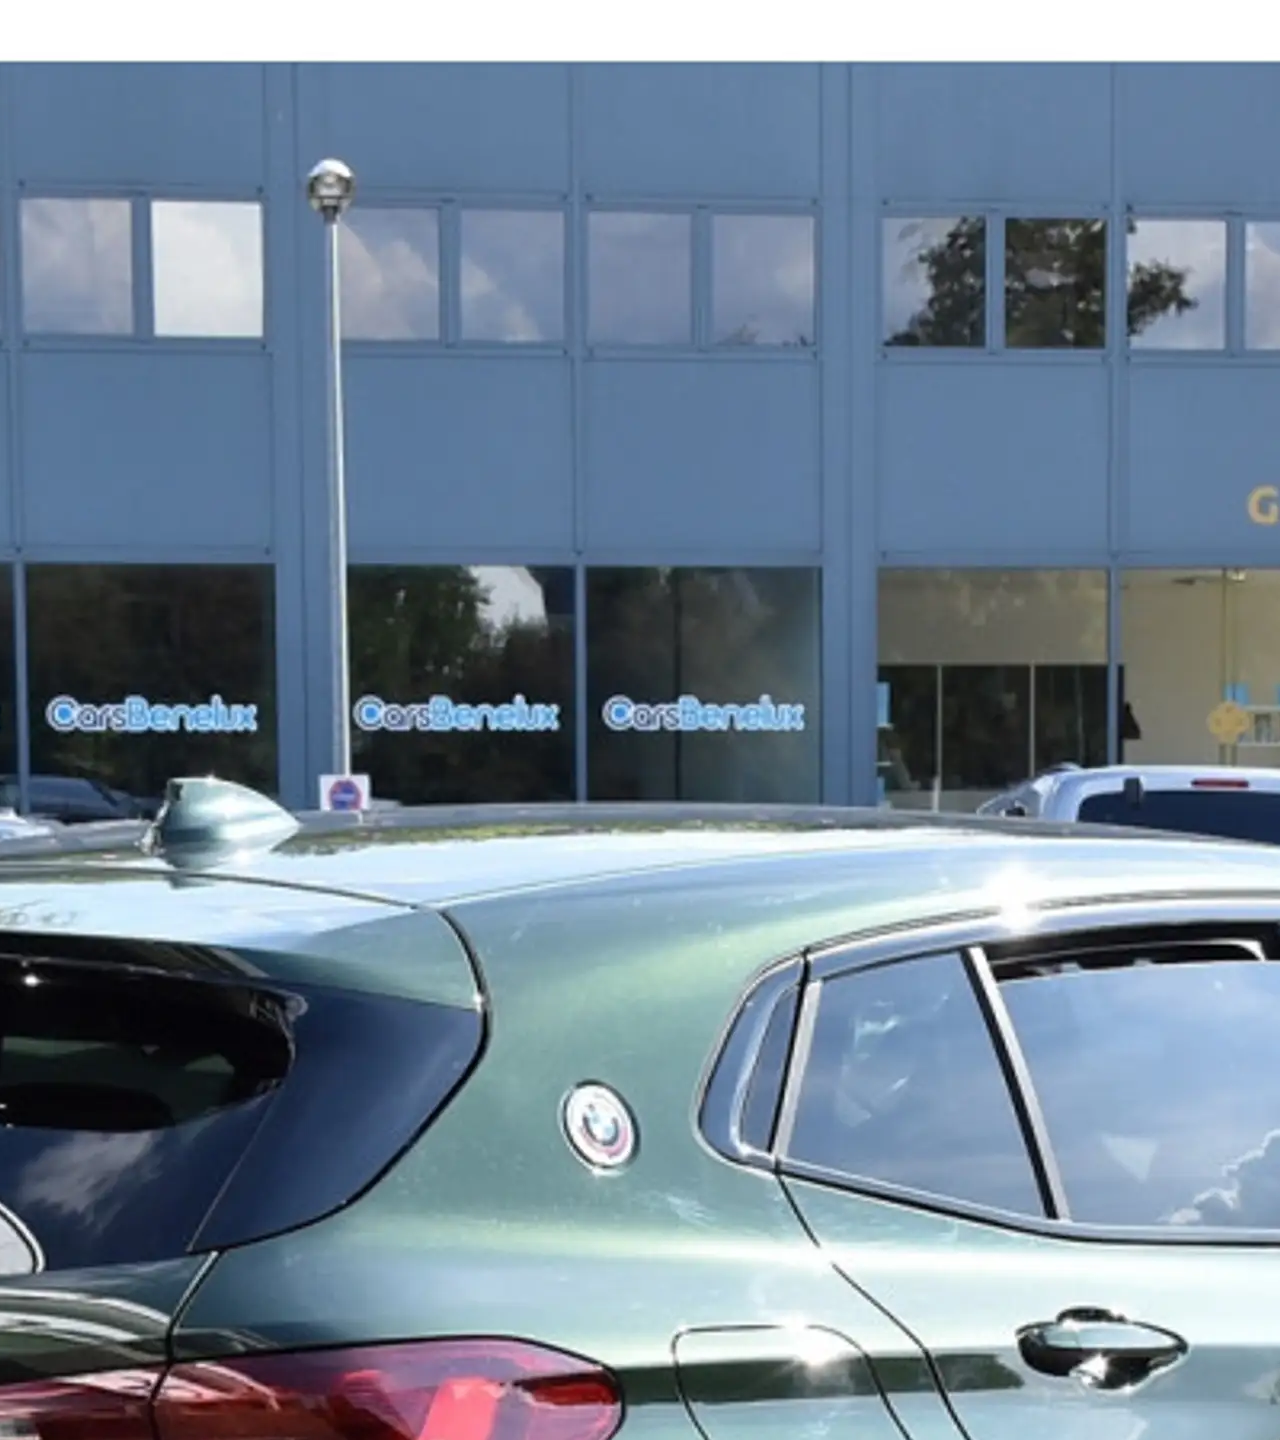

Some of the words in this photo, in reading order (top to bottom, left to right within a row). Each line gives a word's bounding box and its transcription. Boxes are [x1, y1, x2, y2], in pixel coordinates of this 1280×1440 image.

[46, 694, 258, 732] CarsBenelux
[354, 694, 560, 731] CarsBenelux
[603, 694, 804, 731] CarsBenelux
